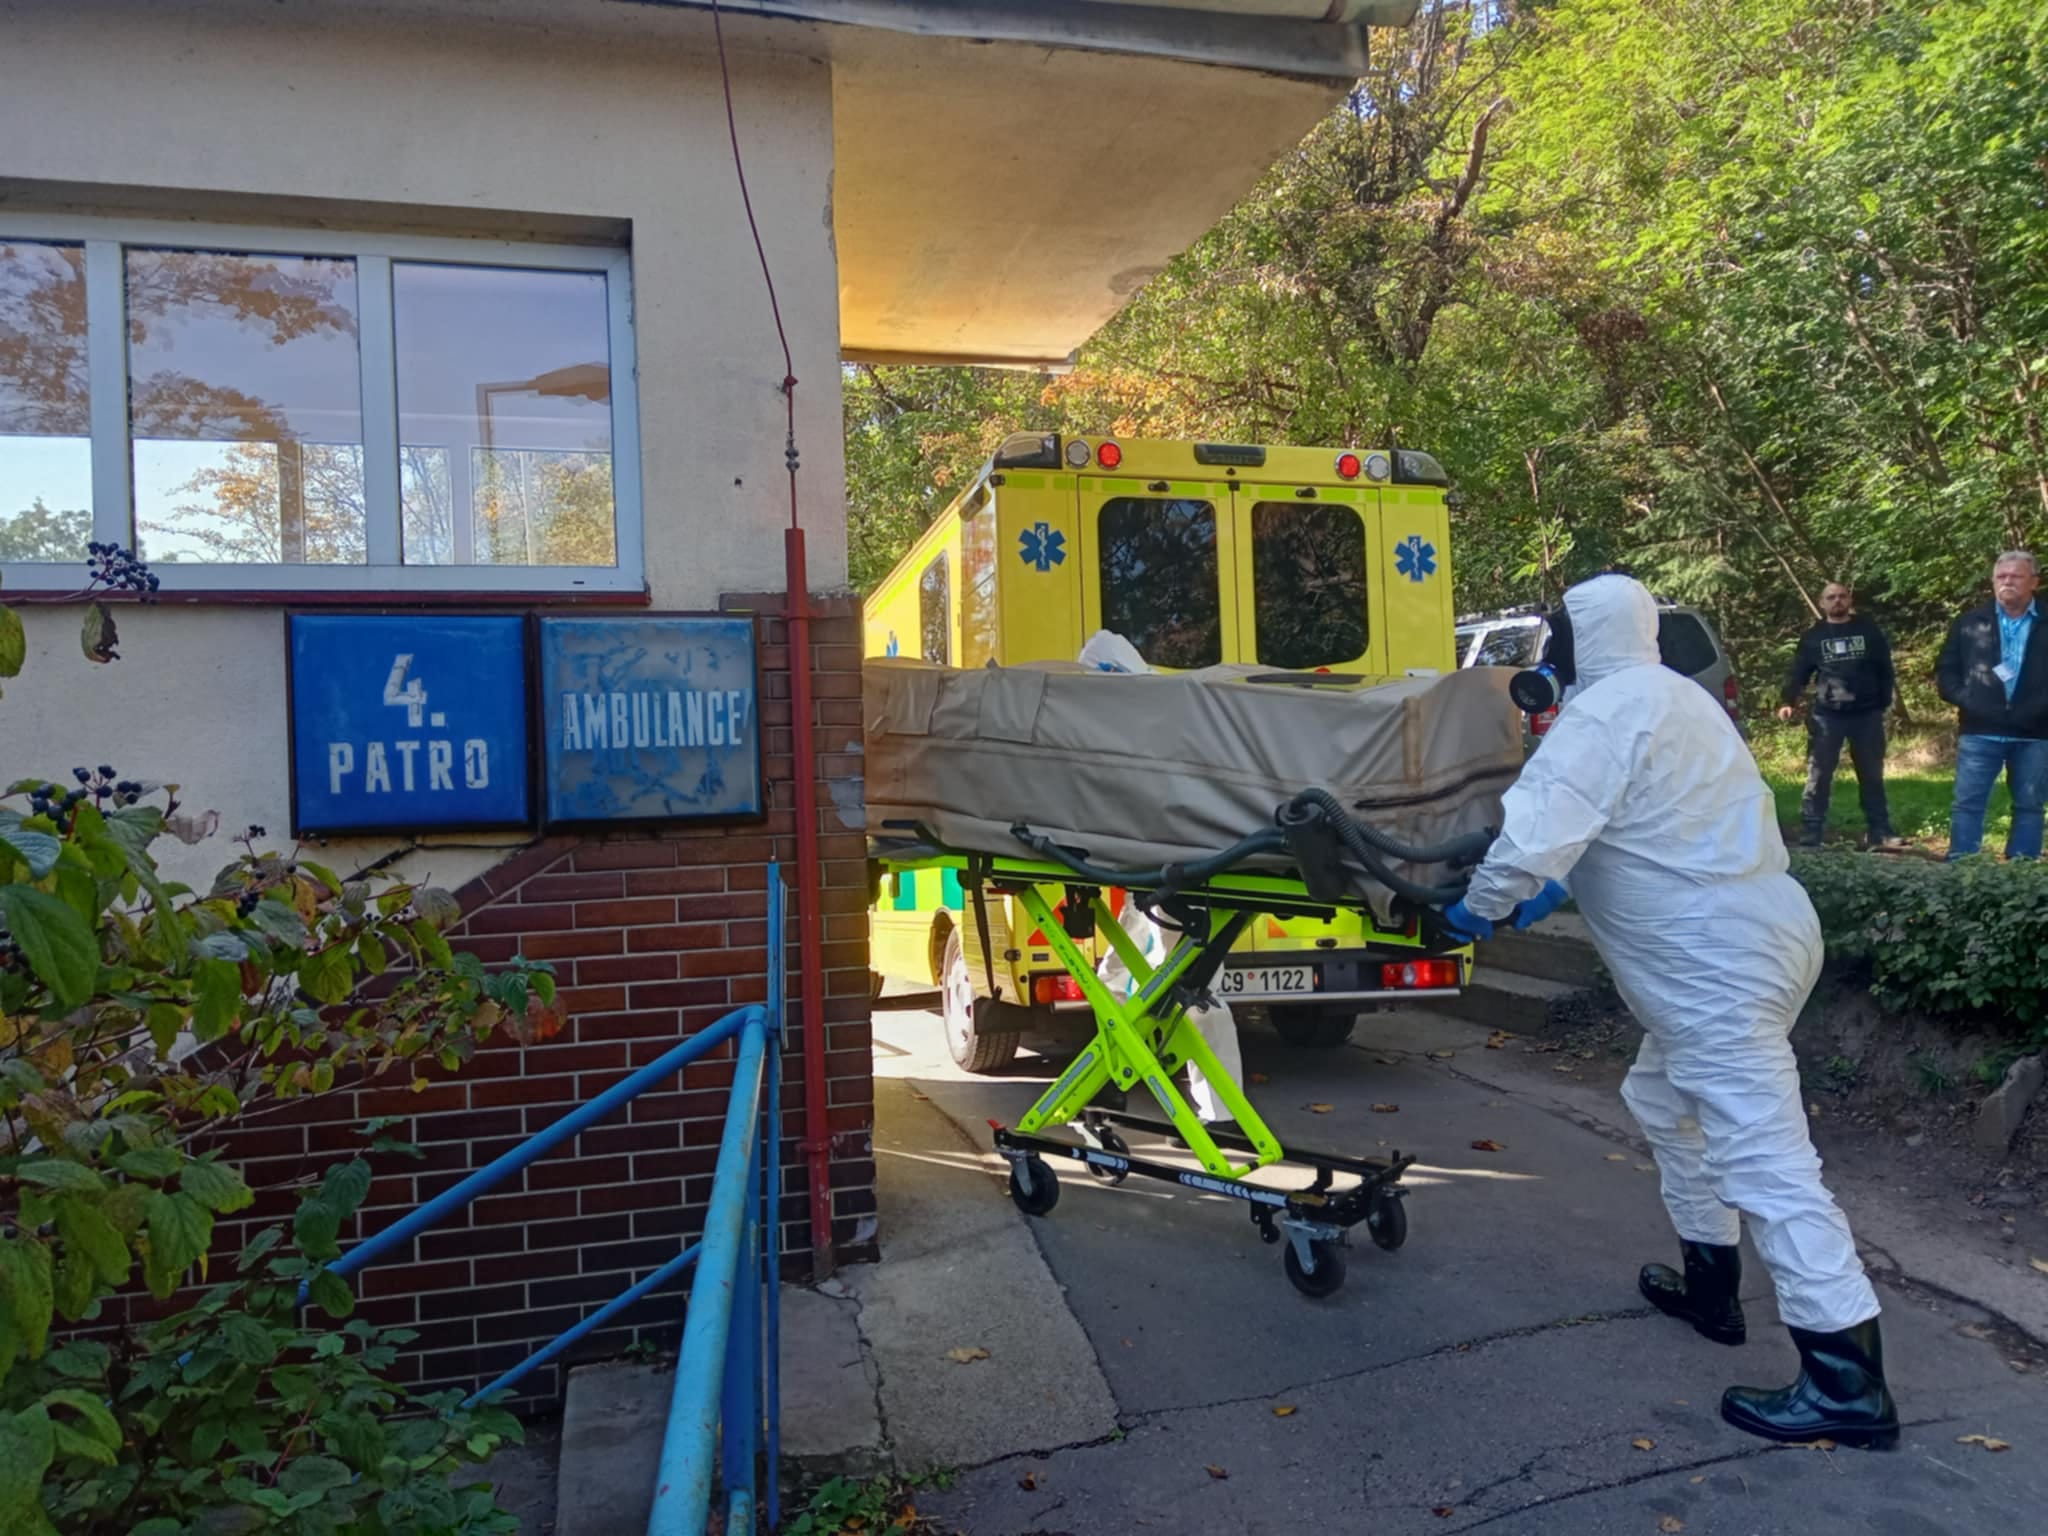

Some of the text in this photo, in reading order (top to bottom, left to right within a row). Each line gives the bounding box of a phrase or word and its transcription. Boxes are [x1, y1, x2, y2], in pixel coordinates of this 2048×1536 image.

[383, 653, 446, 728] 4.
[562, 690, 743, 750] AMBULANCE
[328, 738, 490, 794] PATRO
[1216, 969, 1305, 993] C9 1122
